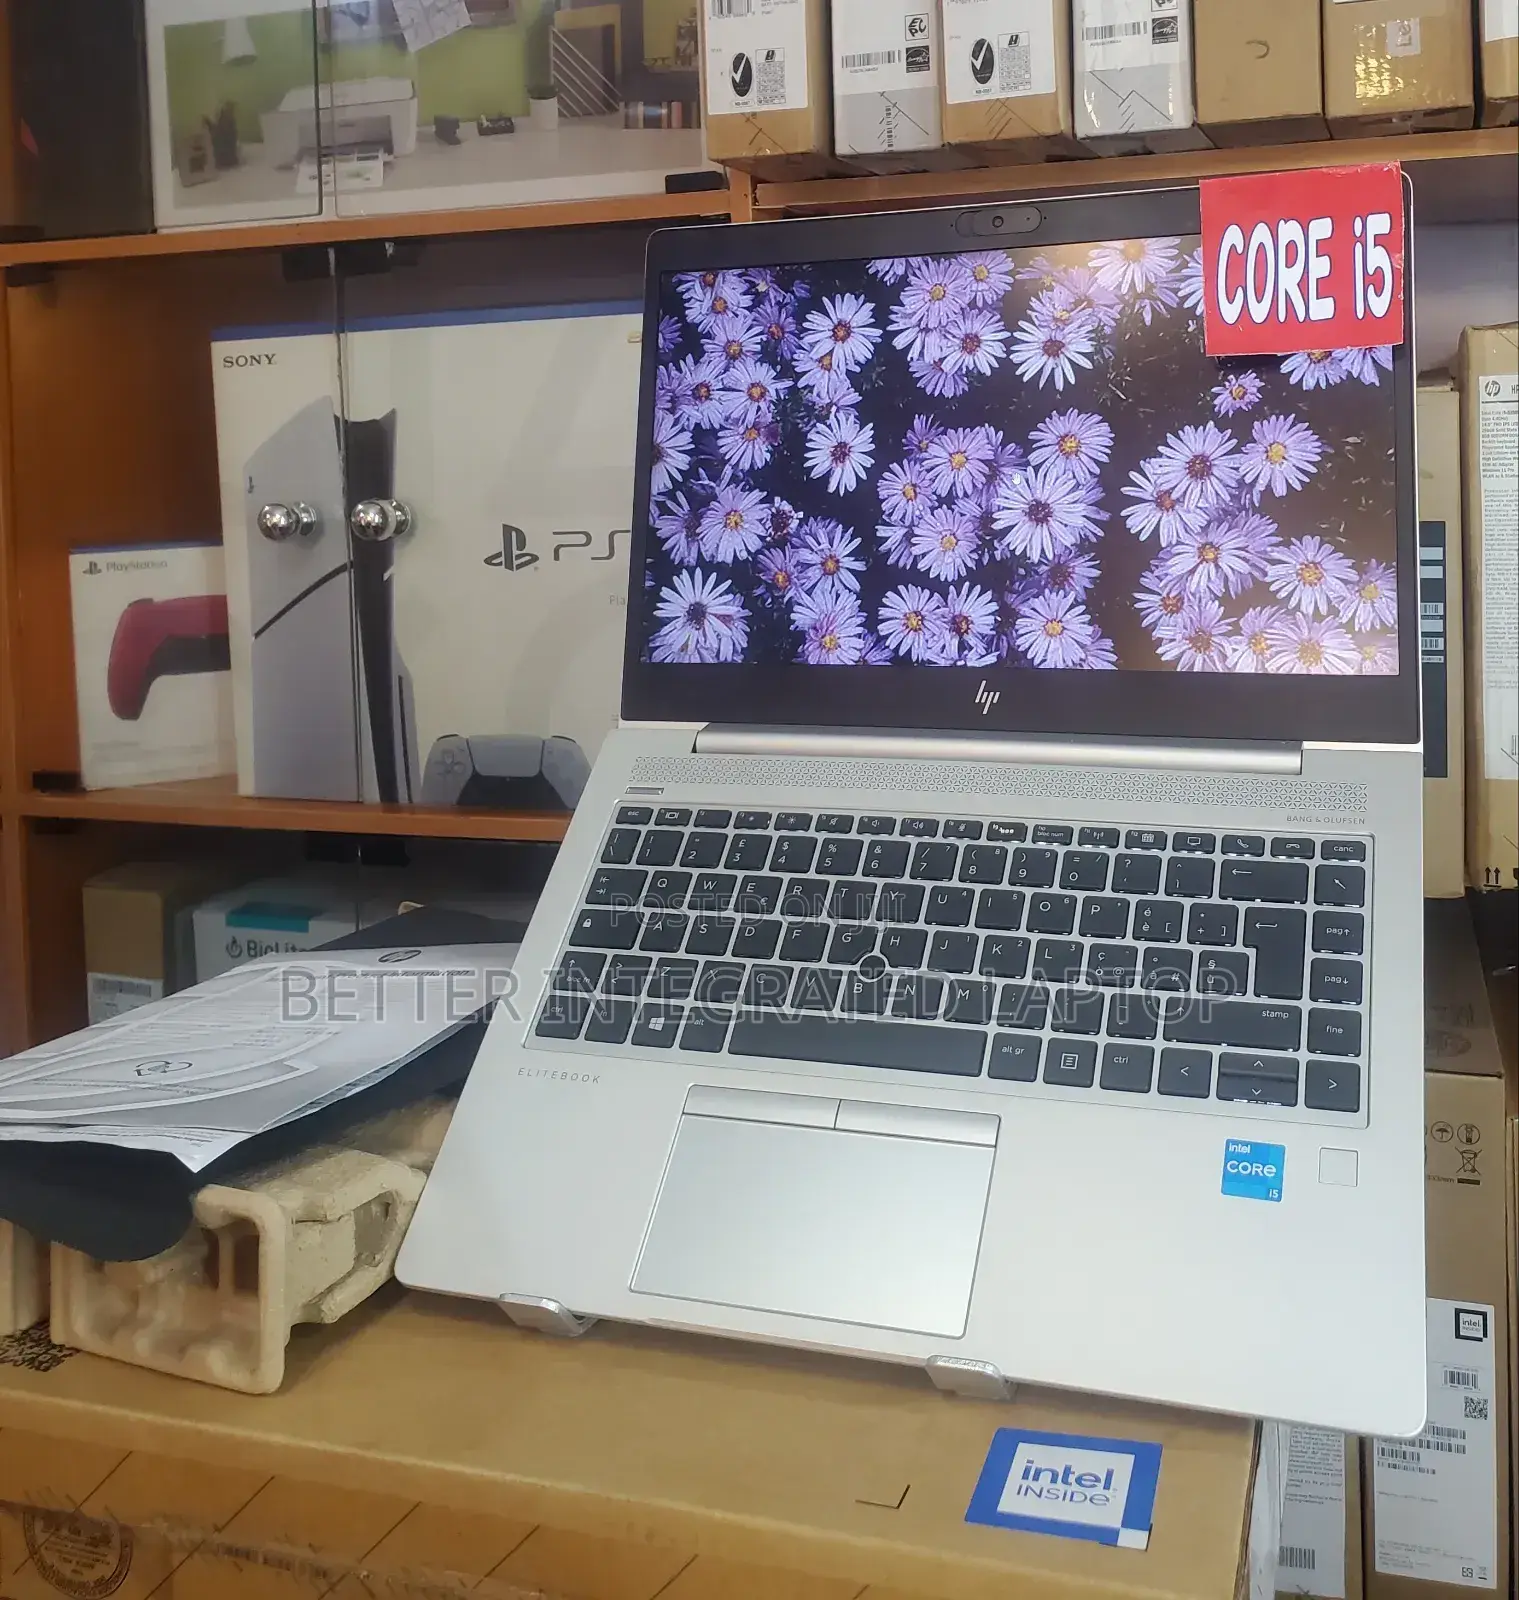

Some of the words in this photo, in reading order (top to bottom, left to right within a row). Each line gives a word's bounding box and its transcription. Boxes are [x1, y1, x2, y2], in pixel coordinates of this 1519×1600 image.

[1217, 216, 1337, 325] CORE
[1353, 212, 1394, 320] i5
[222, 353, 276, 369] SONY
[1286, 814, 1311, 823] BANG
[1323, 816, 1365, 825] OLUFSEN
[738, 838, 746, 848] £
[781, 841, 790, 851] $
[828, 843, 838, 853] %
[1333, 844, 1354, 853] canc
[645, 848, 651, 857] 1
[688, 850, 696, 860] 2
[874, 845, 882, 854] &
[1045, 851, 1051, 859] 9
[732, 853, 741, 862] 3
[777, 855, 786, 864] 4
[824, 858, 832, 867] 5
[871, 859, 879, 869] 6
[919, 862, 928, 872] 7
[1124, 859, 1132, 868] ?
[968, 866, 977, 876] 8
[1018, 868, 1027, 878] 9
[657, 878, 668, 888] Q
[702, 880, 718, 890] W
[745, 882, 757, 892] E
[792, 885, 803, 896] R
[840, 887, 849, 898] T
[889, 890, 899, 901] Y
[936, 893, 948, 904] U
[1063, 896, 1070, 904] 6
[1090, 904, 1101, 915] P
[652, 920, 664, 931] A
[699, 923, 709, 934] S
[1165, 922, 1172, 933] [
[1221, 925, 1227, 936] ]
[1326, 926, 1344, 936] pag
[744, 926, 755, 937] D
[791, 929, 802, 940] F
[841, 932, 852, 943] G
[889, 935, 901, 946] H
[1017, 939, 1023, 947] 2
[940, 939, 949, 950] J
[991, 943, 1003, 955] K
[1044, 948, 1053, 959] L
[660, 966, 671, 977] Z
[707, 969, 719, 981] X
[1111, 966, 1125, 977] @
[1170, 972, 1180, 981] #
[756, 973, 766, 984] C
[806, 976, 817, 988] V
[1324, 974, 1341, 984] pag
[853, 982, 864, 994] B
[905, 983, 917, 995] N
[957, 988, 970, 1000] M
[1261, 1009, 1289, 1020] stamp
[1325, 1023, 1344, 1034] fine
[1001, 1045, 1013, 1054] alt
[1015, 1047, 1025, 1057] gr
[1113, 1055, 1129, 1064] ctrl
[517, 1067, 601, 1084] ELITEBOOK
[1228, 1142, 1251, 1155] intel
[1269, 1188, 1279, 1199] i5
[1461, 1316, 1480, 1328] intel
[1020, 1458, 1115, 1491] intel
